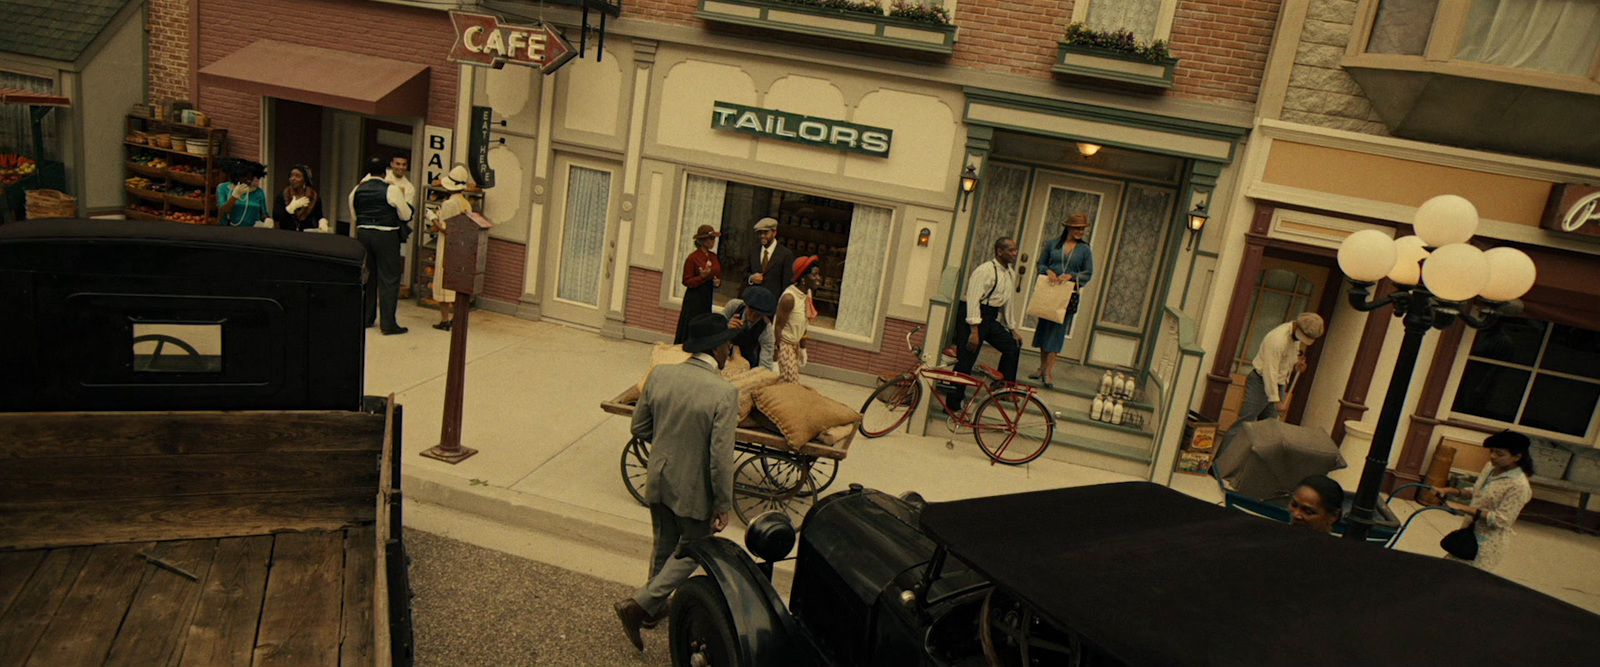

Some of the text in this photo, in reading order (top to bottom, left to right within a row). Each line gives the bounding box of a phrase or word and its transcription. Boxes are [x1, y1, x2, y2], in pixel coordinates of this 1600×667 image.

[463, 25, 547, 61] CAFE
[479, 110, 491, 182] EAT HERE
[713, 106, 889, 153] TAILORS
